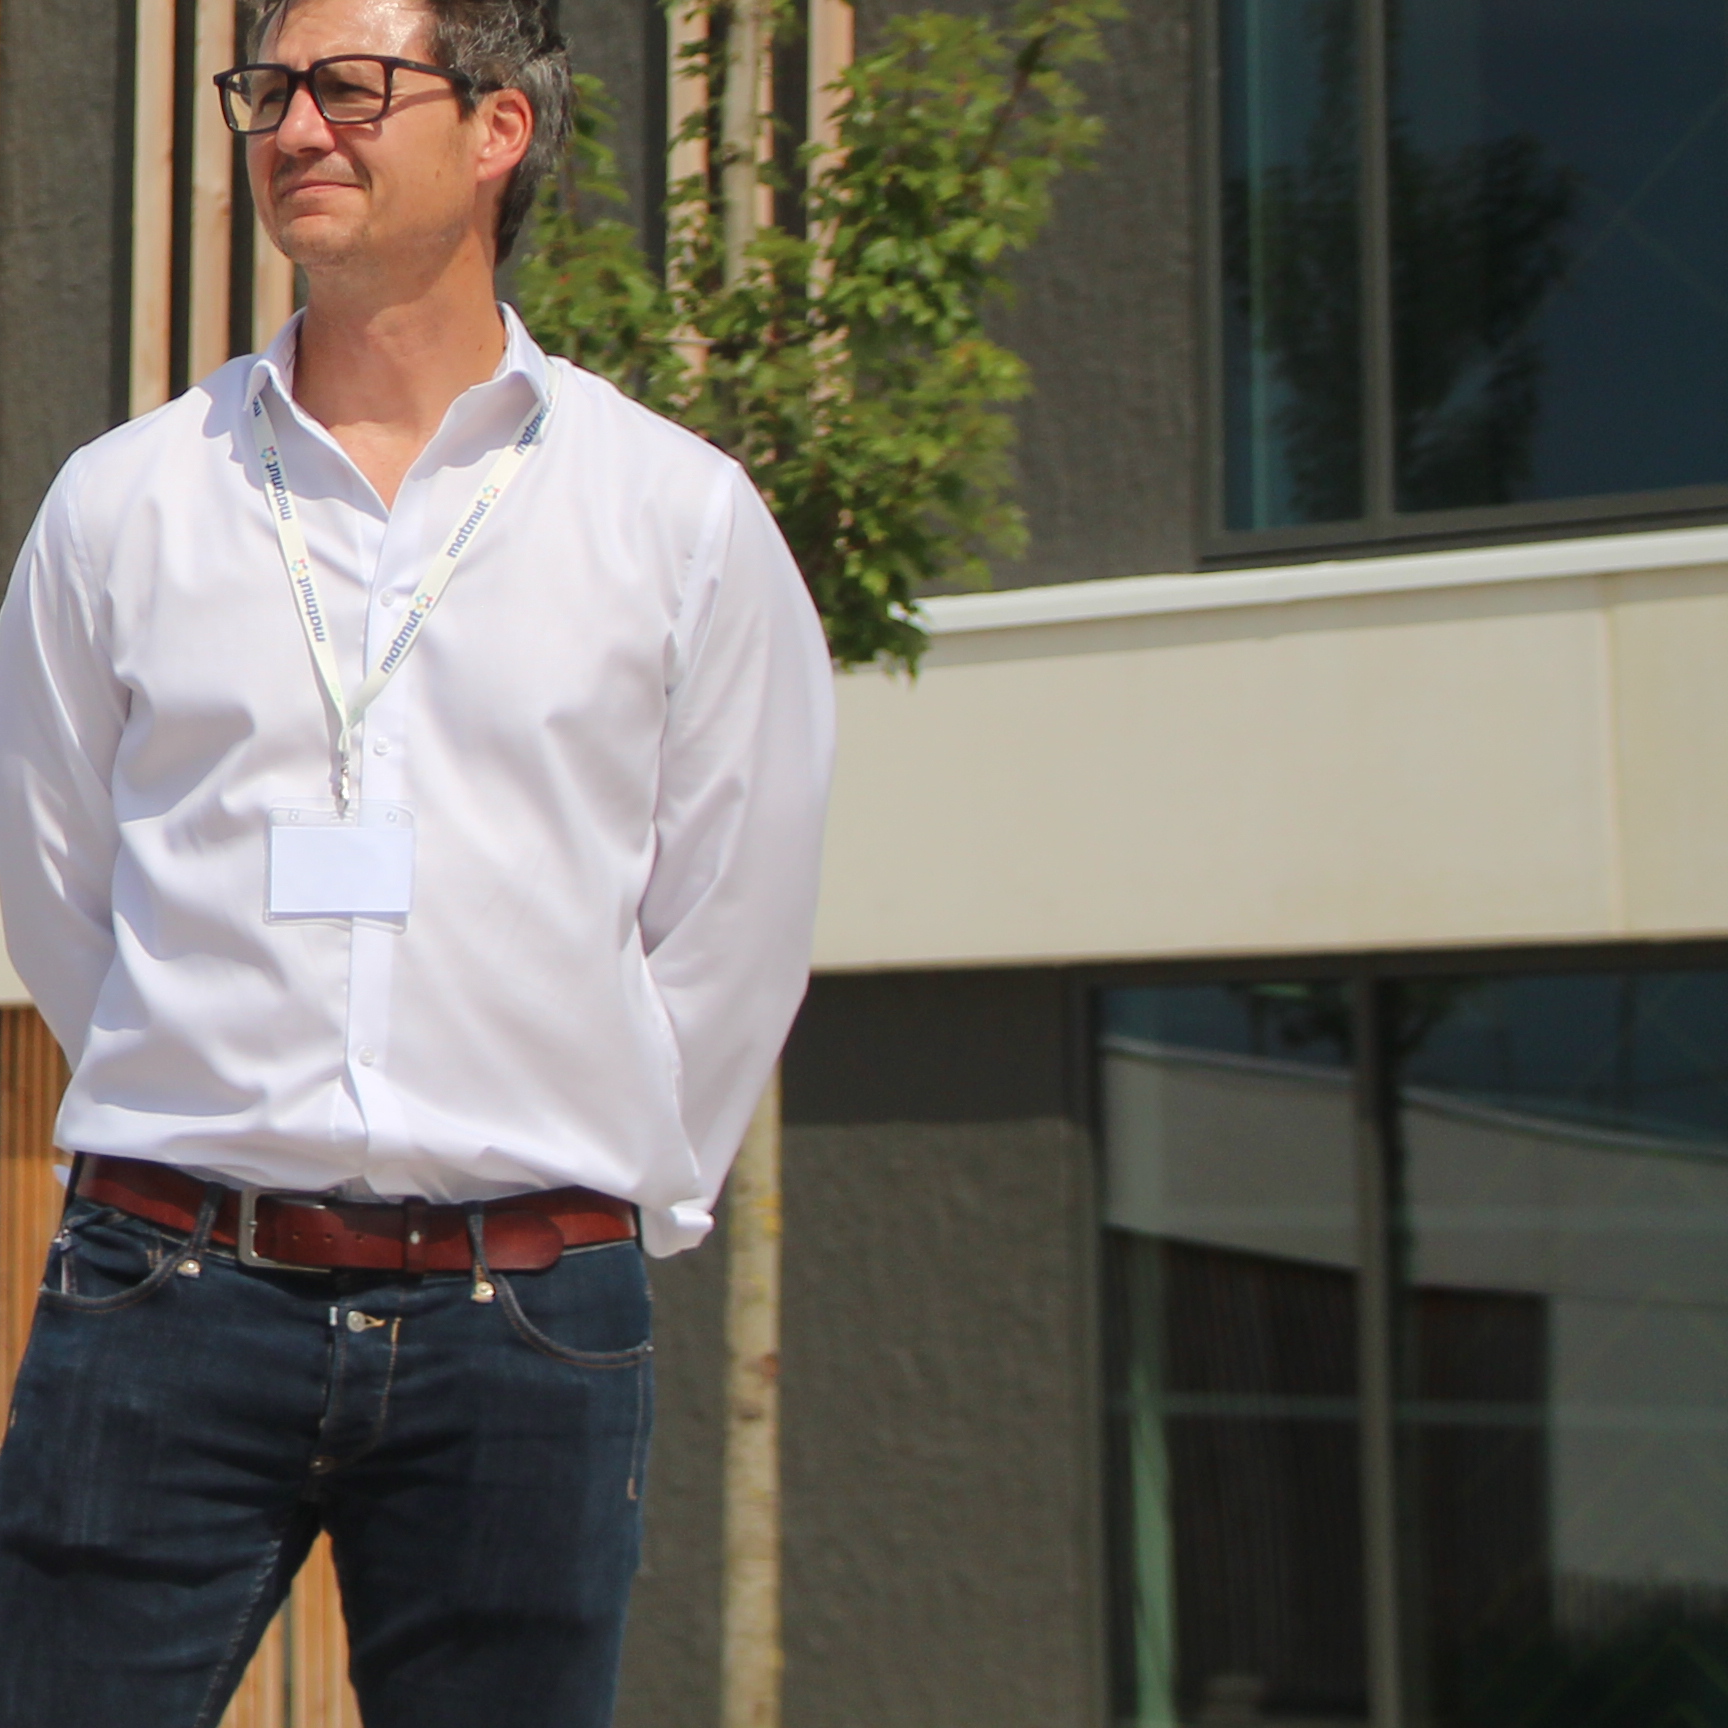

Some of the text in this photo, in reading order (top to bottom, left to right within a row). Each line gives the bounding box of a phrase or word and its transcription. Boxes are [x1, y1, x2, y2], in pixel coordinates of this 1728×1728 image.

[265, 461, 292, 521] matmut
[446, 499, 490, 559] matmut
[296, 575, 326, 642] matmut
[380, 609, 423, 674] matmut
